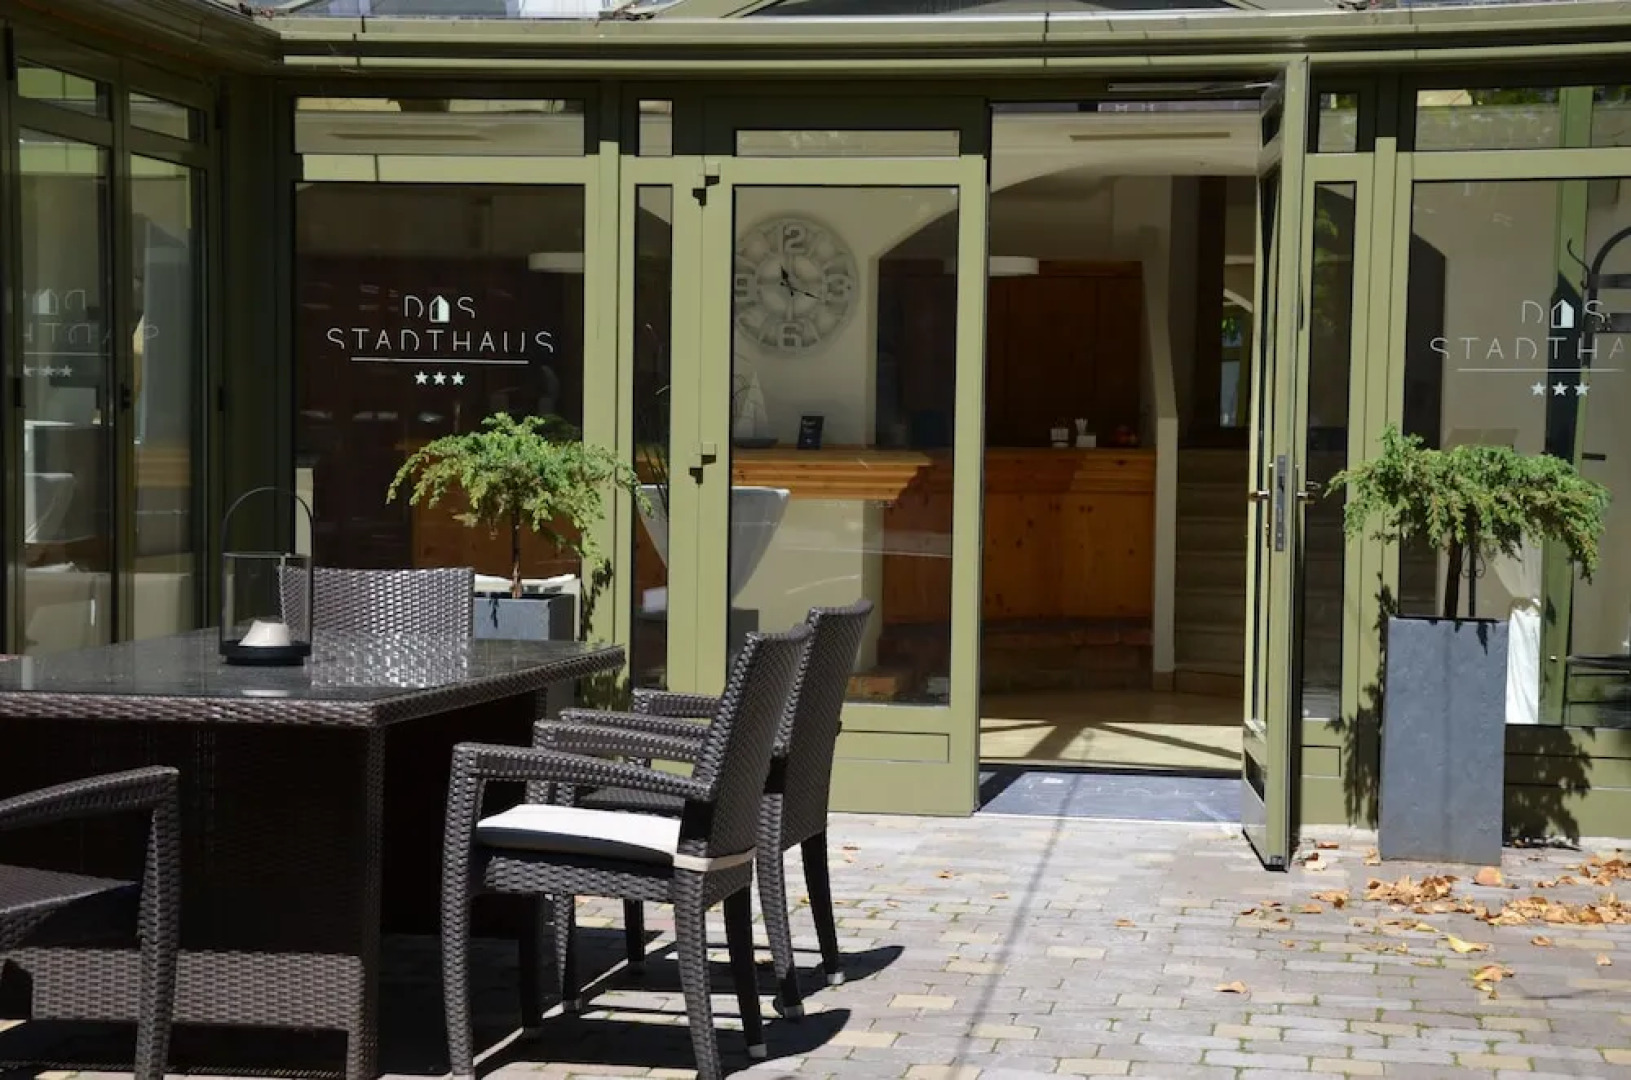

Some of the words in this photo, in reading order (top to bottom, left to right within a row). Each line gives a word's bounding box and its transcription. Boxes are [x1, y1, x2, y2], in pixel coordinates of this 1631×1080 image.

[404, 295, 476, 323] DAS
[1521, 299, 1606, 328] DAS
[326, 327, 554, 353] STADTHAUS
